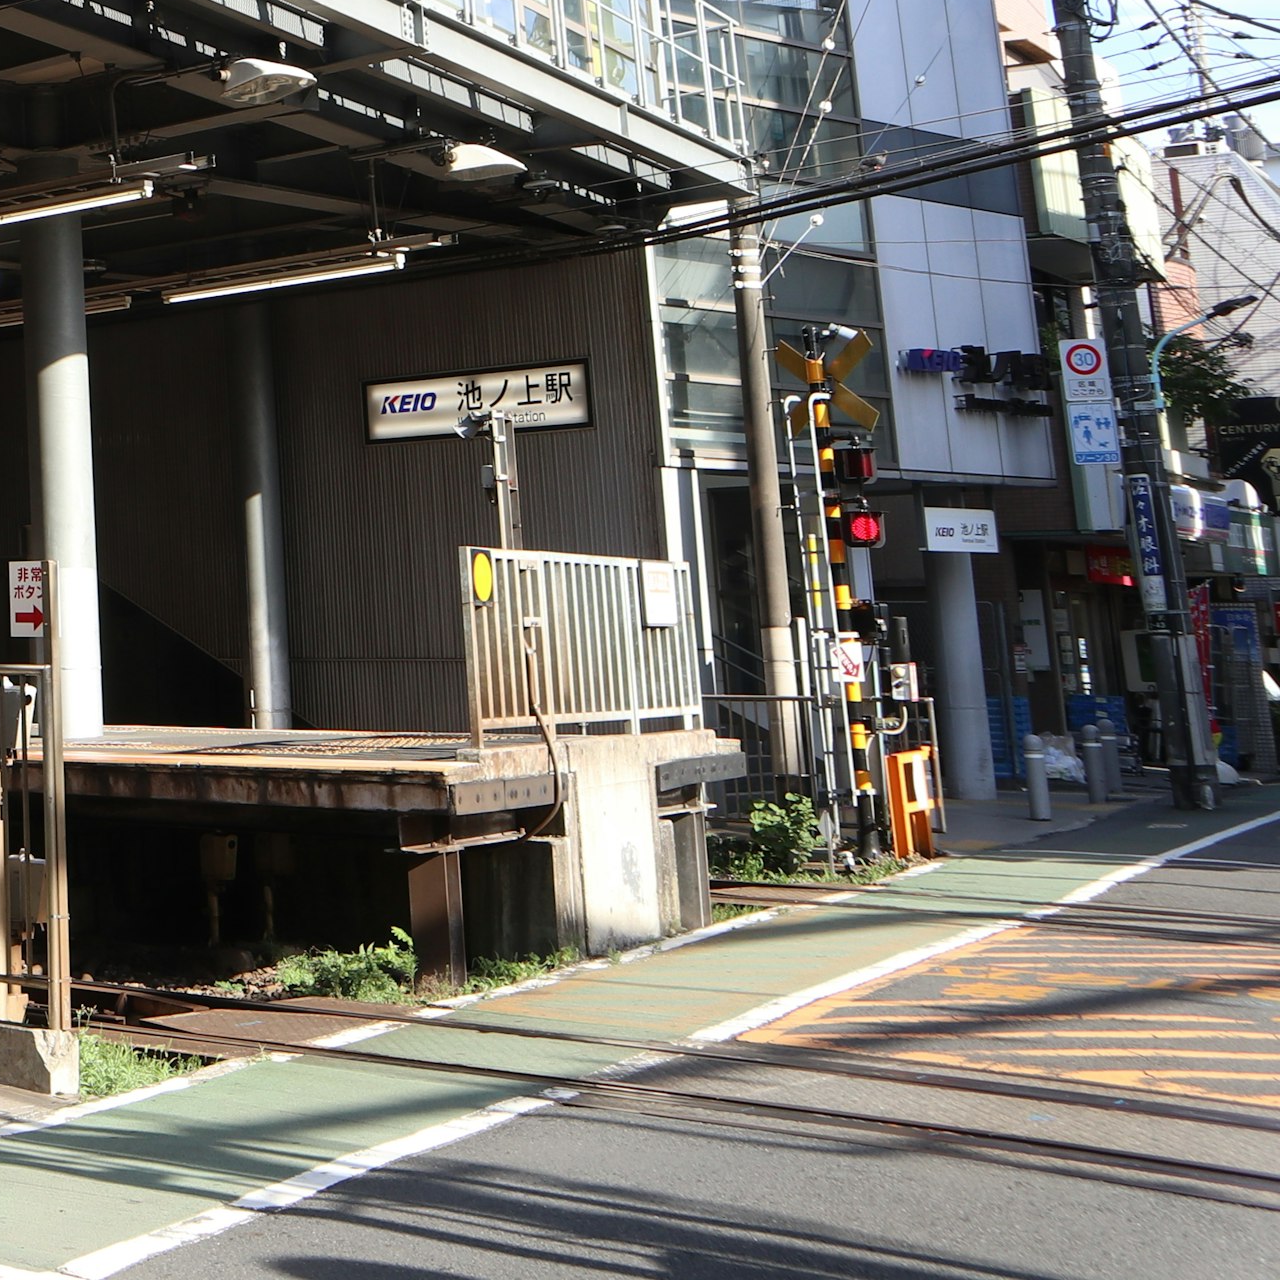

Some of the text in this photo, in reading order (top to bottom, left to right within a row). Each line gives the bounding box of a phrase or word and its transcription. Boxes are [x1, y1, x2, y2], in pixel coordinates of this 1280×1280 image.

[1073, 352, 1095, 367] 30
[456, 371, 574, 412] 池ノ上駅
[380, 391, 437, 415] KEIO
[513, 410, 546, 424] tation
[1219, 423, 1280, 436] CENTURY
[935, 526, 955, 537] KEIO
[1131, 479, 1161, 573] 佐々木眼科
